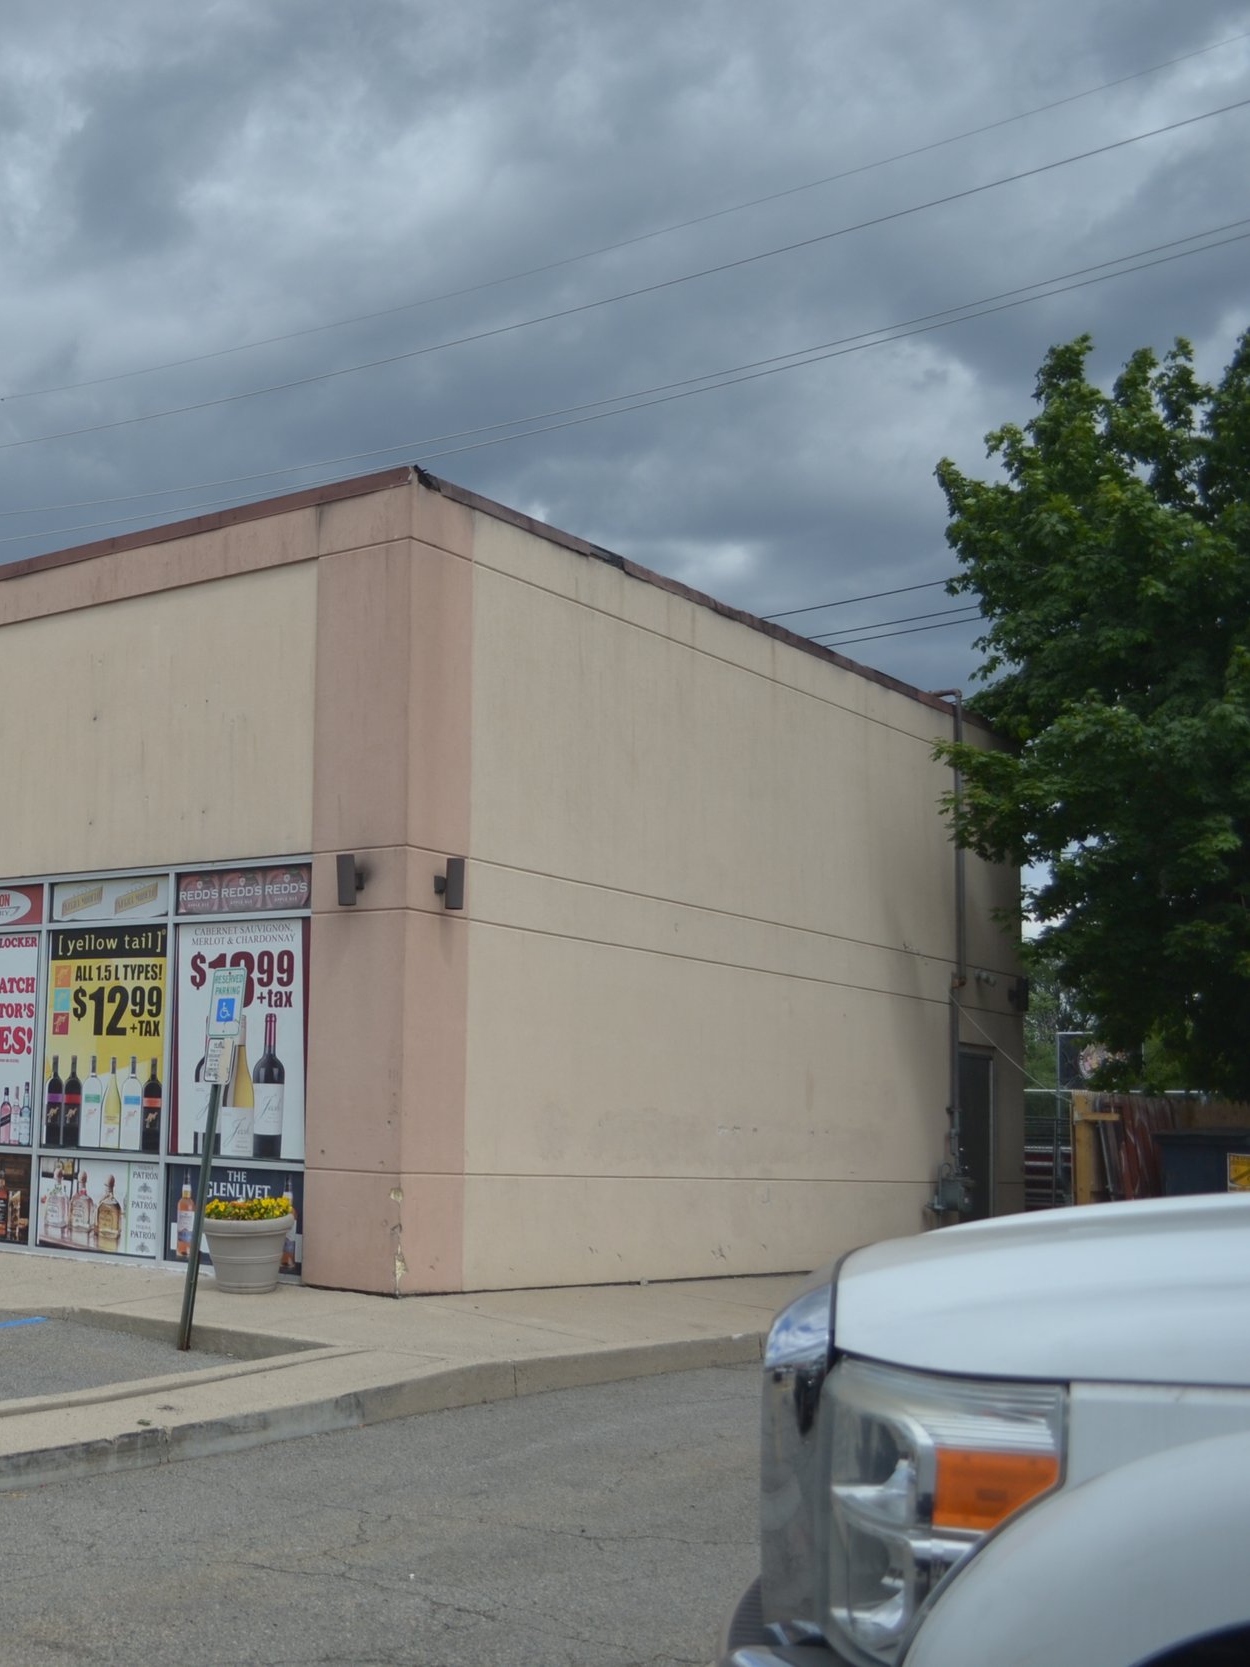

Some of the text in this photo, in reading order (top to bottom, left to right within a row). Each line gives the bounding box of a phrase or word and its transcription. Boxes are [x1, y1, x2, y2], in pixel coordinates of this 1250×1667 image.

[194, 924, 293, 936] CABERNET SAUVIGNON,
[0, 936, 37, 948] LOCKER
[66, 934, 118, 956] yellow
[124, 932, 152, 950] tail
[191, 933, 296, 946] MERLOT & CHARDONNAY
[75, 964, 162, 981] ALL 1.5 L TYPES!
[214, 973, 244, 985] RESERVED
[215, 985, 240, 995] PARKING
[226, 1169, 247, 1182] THE
